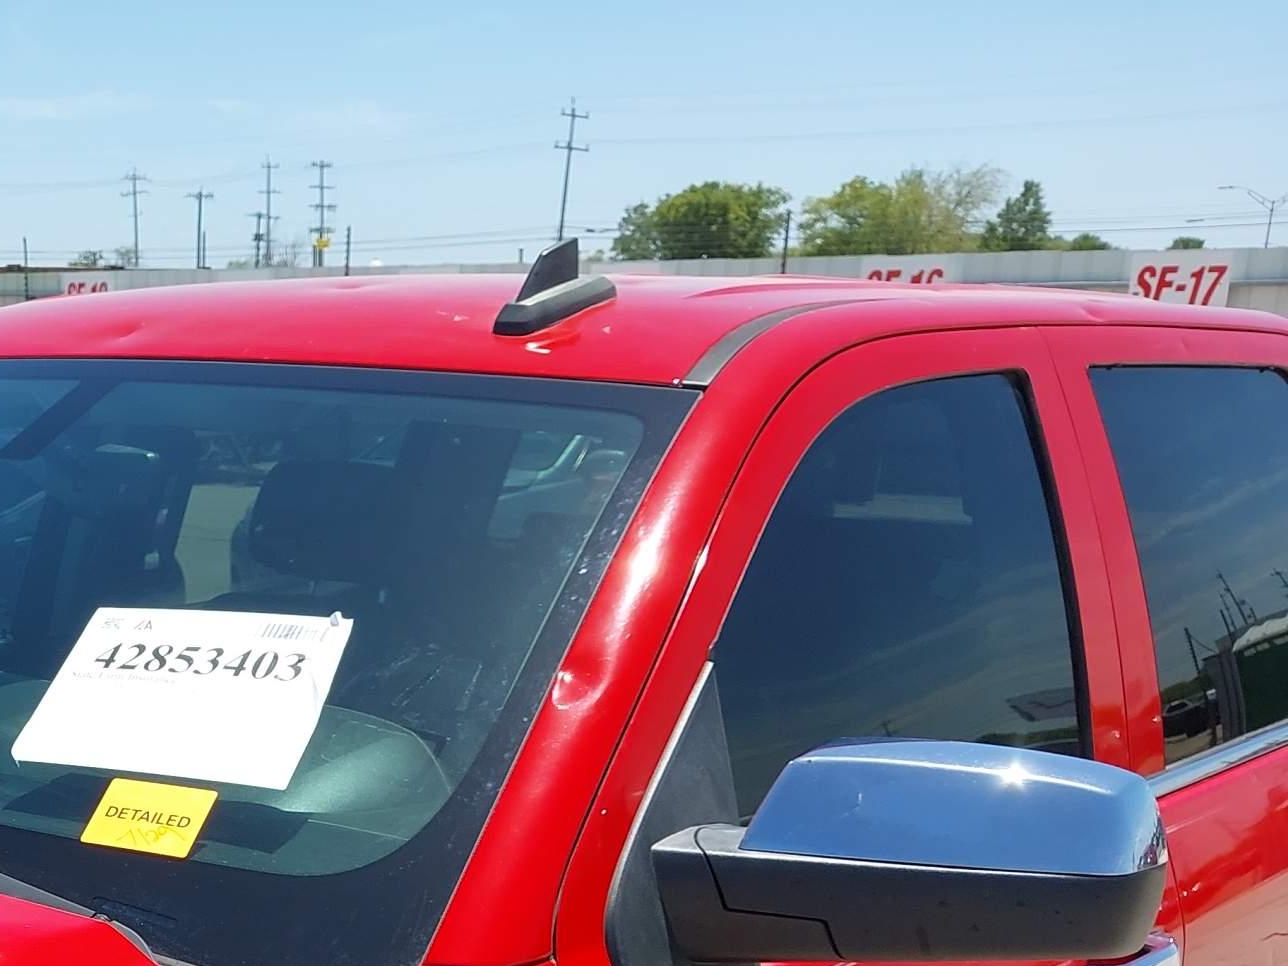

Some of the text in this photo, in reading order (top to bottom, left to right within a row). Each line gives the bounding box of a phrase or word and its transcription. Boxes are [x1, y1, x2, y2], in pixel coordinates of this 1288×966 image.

[1135, 264, 1229, 306] SF-17
[94, 641, 307, 683] 42853403
[104, 805, 191, 829] DETAILED
